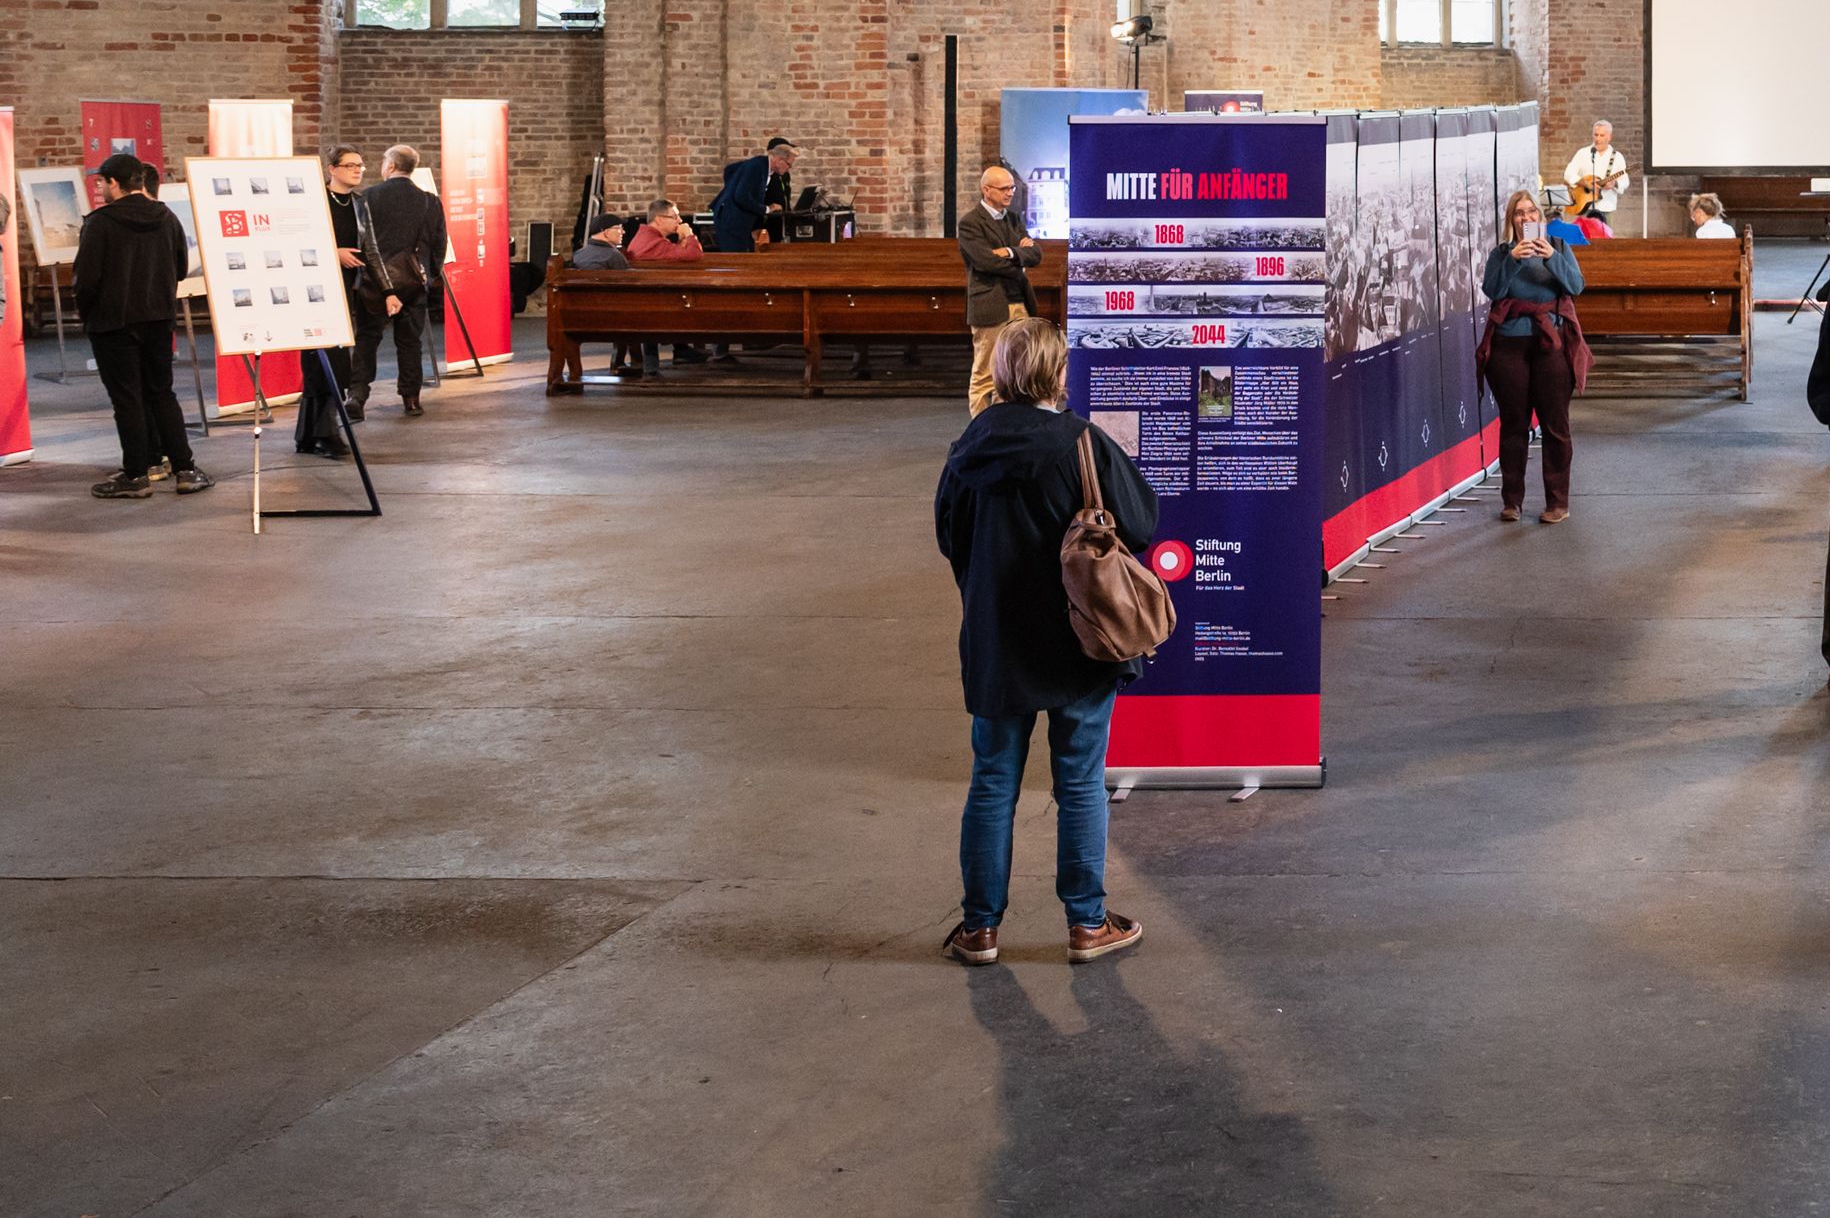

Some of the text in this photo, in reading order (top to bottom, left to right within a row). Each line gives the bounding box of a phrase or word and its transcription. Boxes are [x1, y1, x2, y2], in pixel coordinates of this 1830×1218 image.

[1107, 168, 1288, 200] MITTE FÜR ANFÄNGER
[253, 214, 270, 225] IN
[1155, 225, 1184, 244] 1868
[1256, 257, 1284, 276] 1896
[1105, 291, 1135, 310] 1968
[1192, 325, 1225, 344] 2044
[1196, 539, 1241, 553] Stiftung
[1196, 555, 1225, 566] Mitte
[1196, 570, 1231, 581] Berlin
